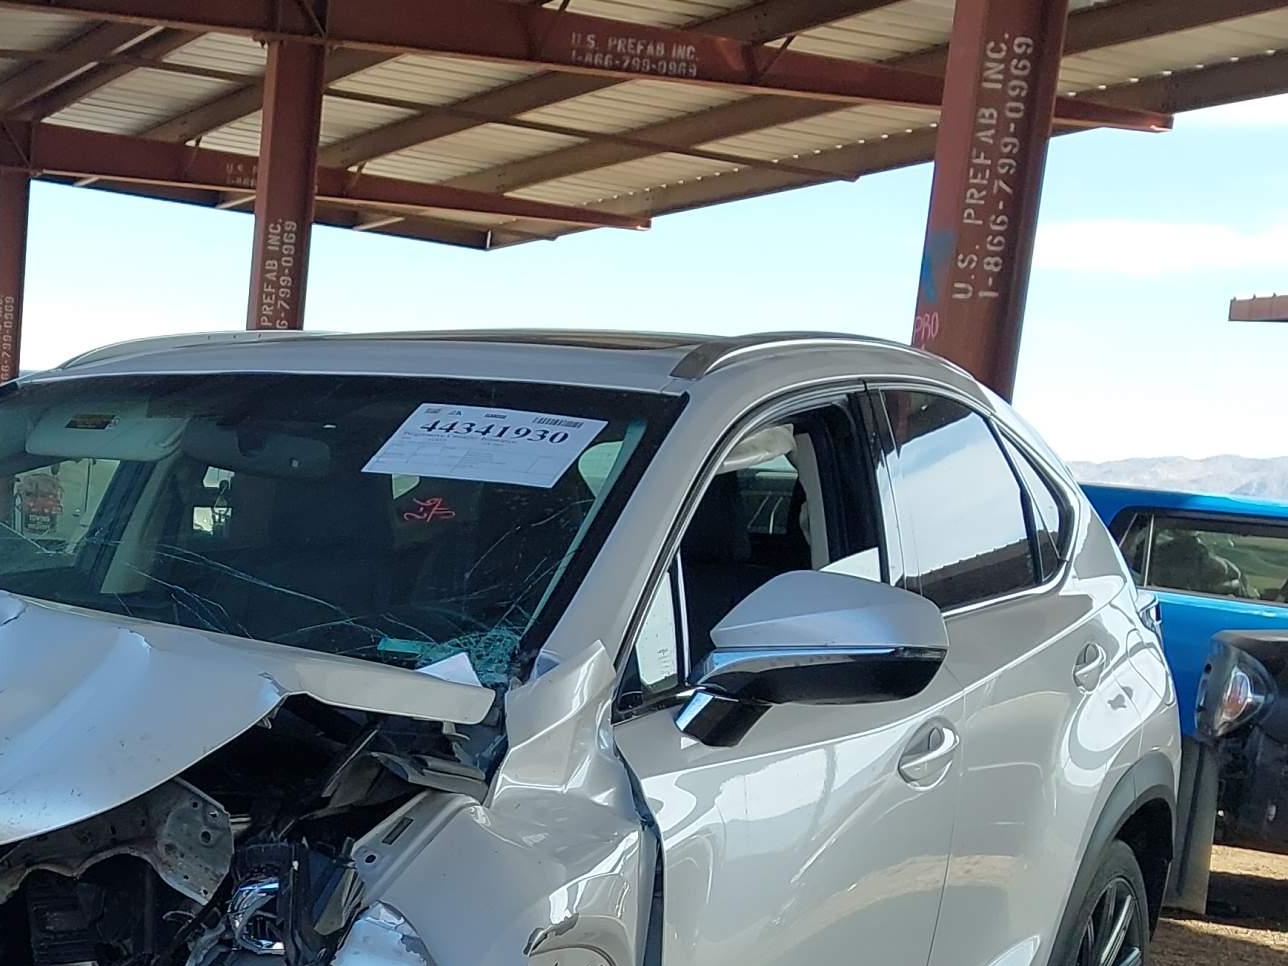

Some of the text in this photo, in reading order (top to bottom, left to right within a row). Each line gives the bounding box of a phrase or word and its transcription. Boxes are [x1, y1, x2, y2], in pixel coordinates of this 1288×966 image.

[570, 50, 698, 77] 1-866-799-0969
[571, 31, 700, 62] U.S. PREFAB INC.
[952, 32, 1010, 299] U.S. PREFAB INC.
[978, 36, 1034, 298] 1-866-799-0969
[261, 218, 283, 326] PREFAB INC.
[1, 296, 15, 383] 66-799-0969
[419, 419, 570, 445] 44341930
